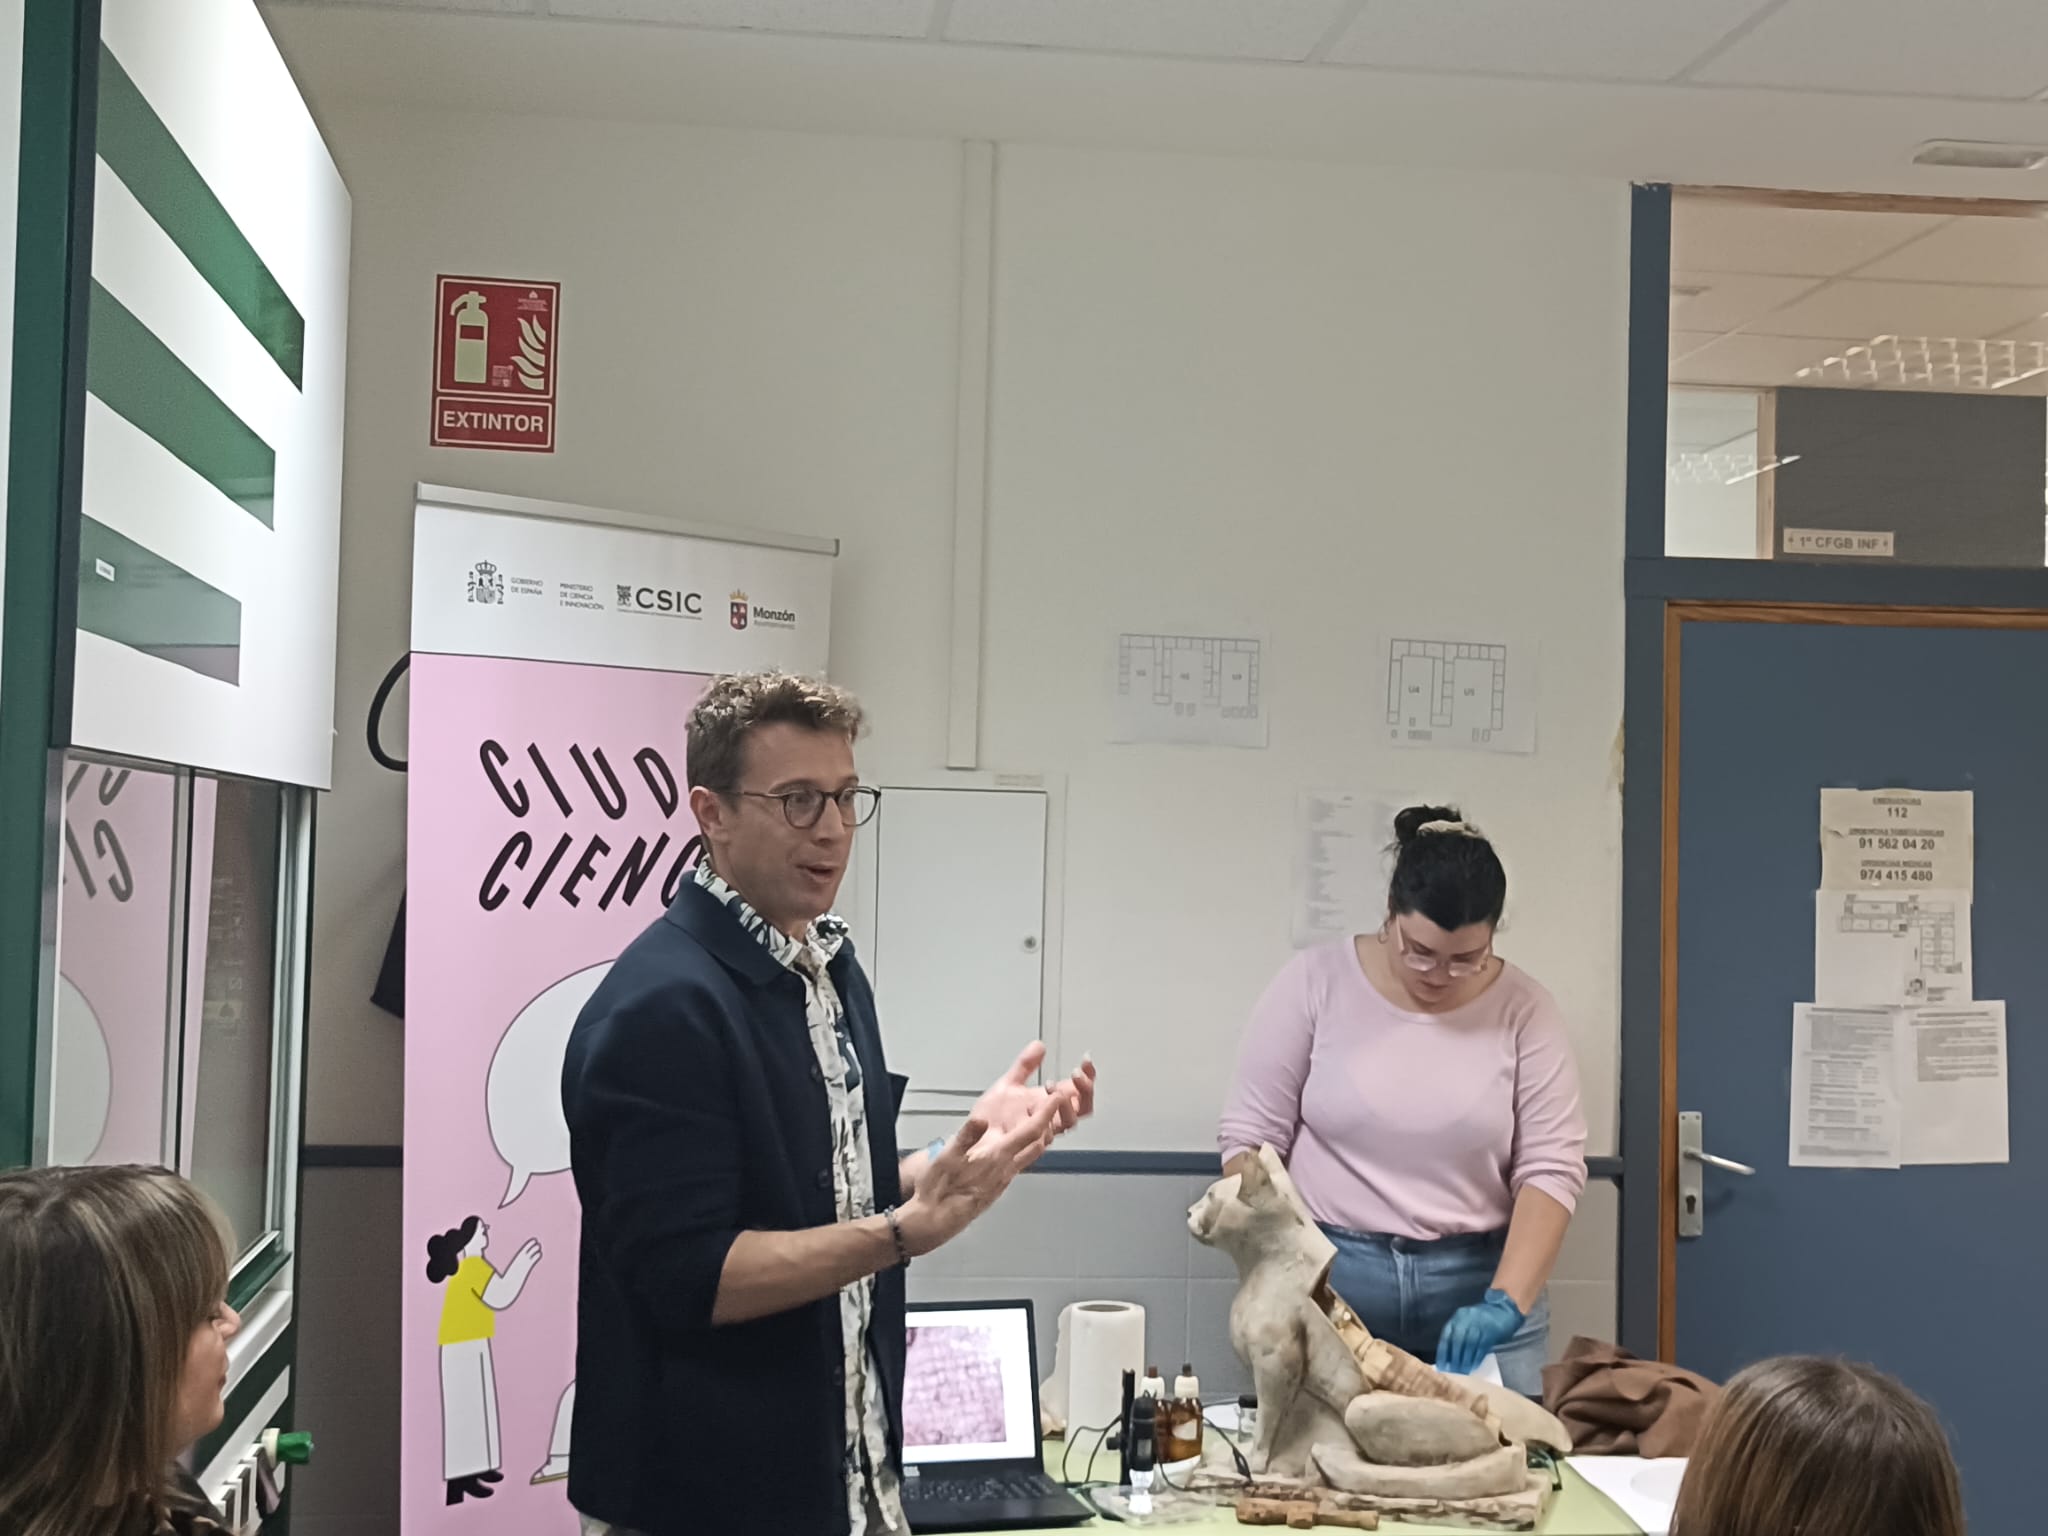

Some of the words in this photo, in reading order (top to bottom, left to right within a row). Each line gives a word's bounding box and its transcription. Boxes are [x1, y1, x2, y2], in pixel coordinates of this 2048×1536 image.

[443, 410, 544, 432] EXTINTOR
[1815, 537, 1853, 549] CFGB
[1857, 538, 1879, 549] INF
[635, 587, 703, 615] CSIC
[753, 606, 796, 622] Monzón
[479, 739, 680, 820] CIUD
[1887, 807, 1908, 818] 112
[1858, 837, 1873, 849] 91
[1878, 839, 1899, 850] 562
[1902, 839, 1917, 849] 04
[1920, 839, 1936, 851] 20
[478, 830, 707, 912] CIENC
[1860, 869, 1882, 880] 974
[1885, 870, 1908, 881] 415
[1910, 870, 1933, 882] 480
